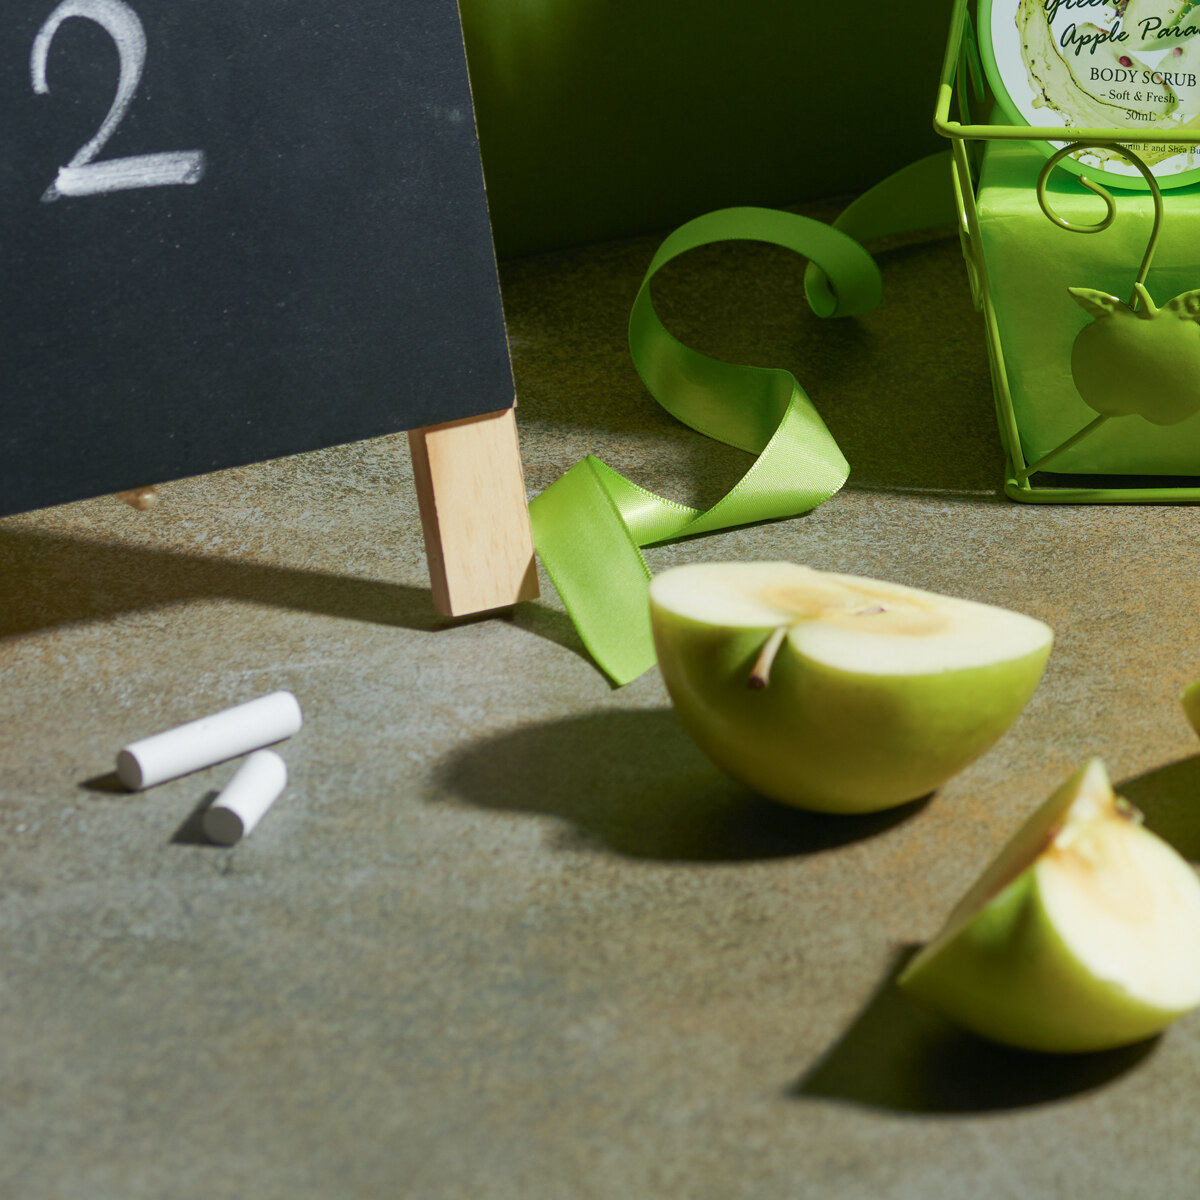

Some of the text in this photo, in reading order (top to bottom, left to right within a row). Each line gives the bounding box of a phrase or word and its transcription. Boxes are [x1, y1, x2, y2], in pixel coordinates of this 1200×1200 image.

[1060, 20, 1130, 56] Apple
[1090, 67, 1197, 87] BODY SCRUB
[1108, 89, 1130, 101] Soft
[1133, 90, 1143, 101] &
[1146, 91, 1175, 104] Fresh
[1125, 109, 1157, 122] 50mL
[1143, 143, 1149, 151] E
[1151, 144, 1166, 152] and
